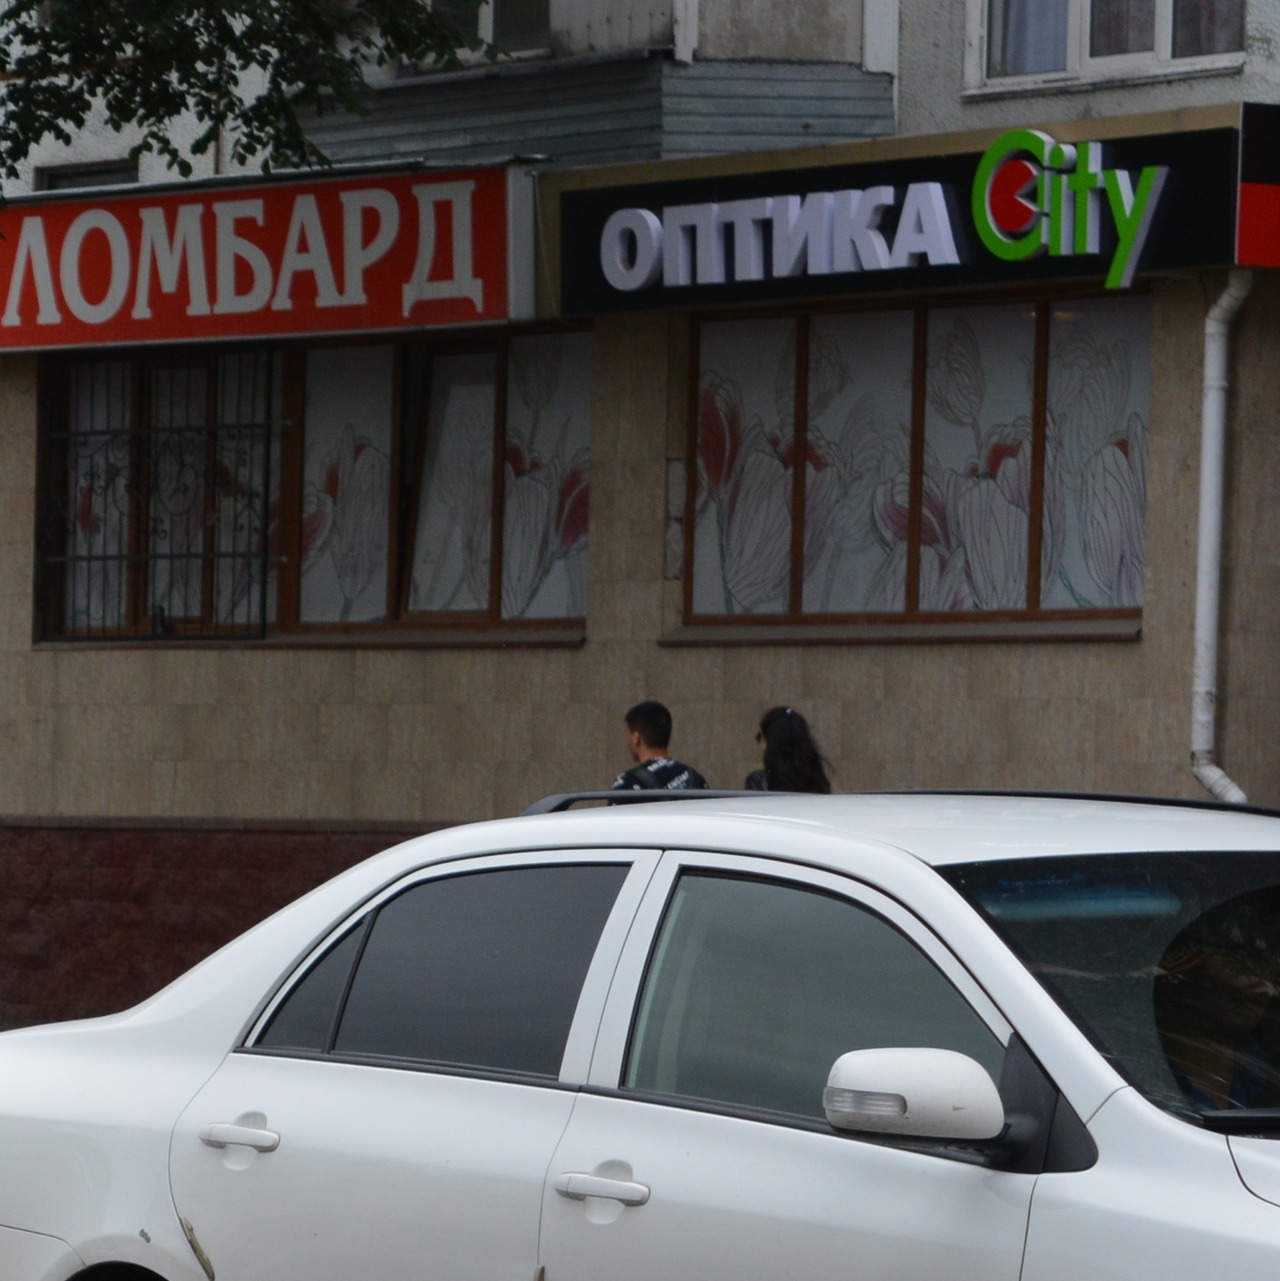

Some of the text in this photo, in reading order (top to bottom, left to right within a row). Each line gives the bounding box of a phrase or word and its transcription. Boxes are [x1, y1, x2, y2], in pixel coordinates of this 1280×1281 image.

[0, 180, 484, 327] ЛОМБАРД
[600, 129, 1168, 291] ОПТИКА City
